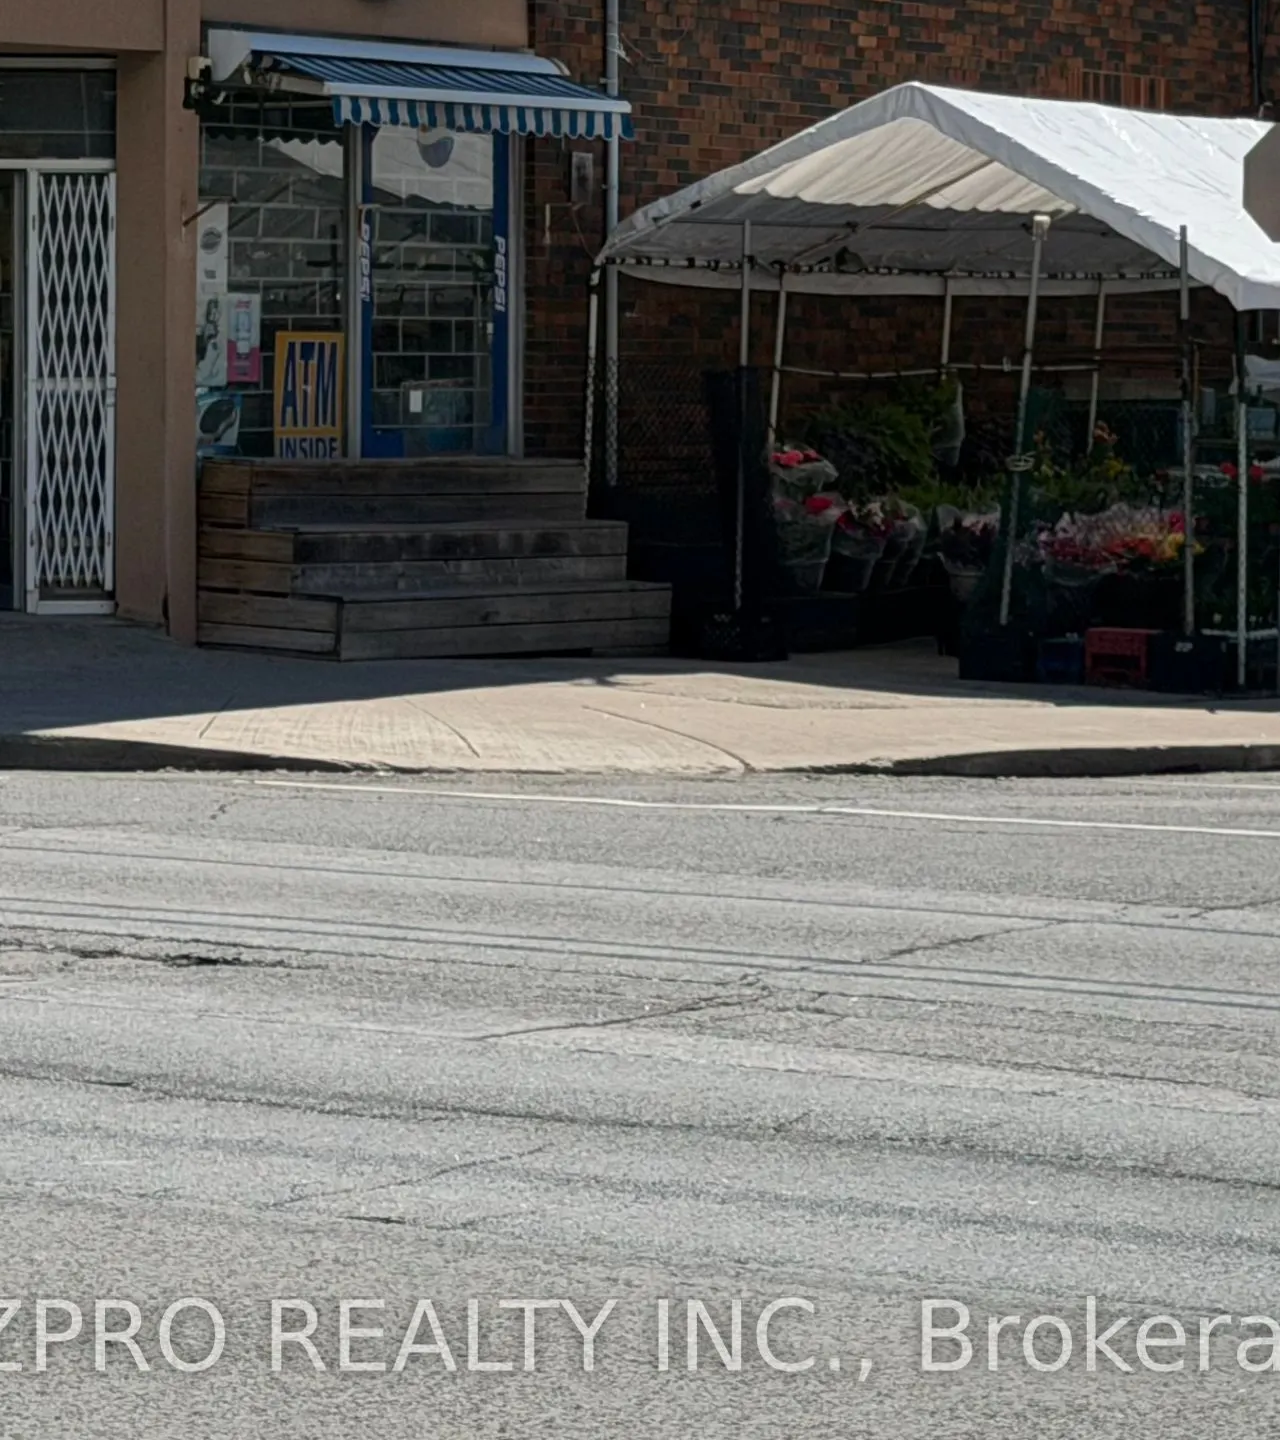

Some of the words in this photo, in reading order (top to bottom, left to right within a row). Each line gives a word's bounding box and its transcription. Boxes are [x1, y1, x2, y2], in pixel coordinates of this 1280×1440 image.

[494, 234, 508, 312] PEPSI
[281, 341, 337, 427] ATM
[279, 437, 338, 458] INSIDE
